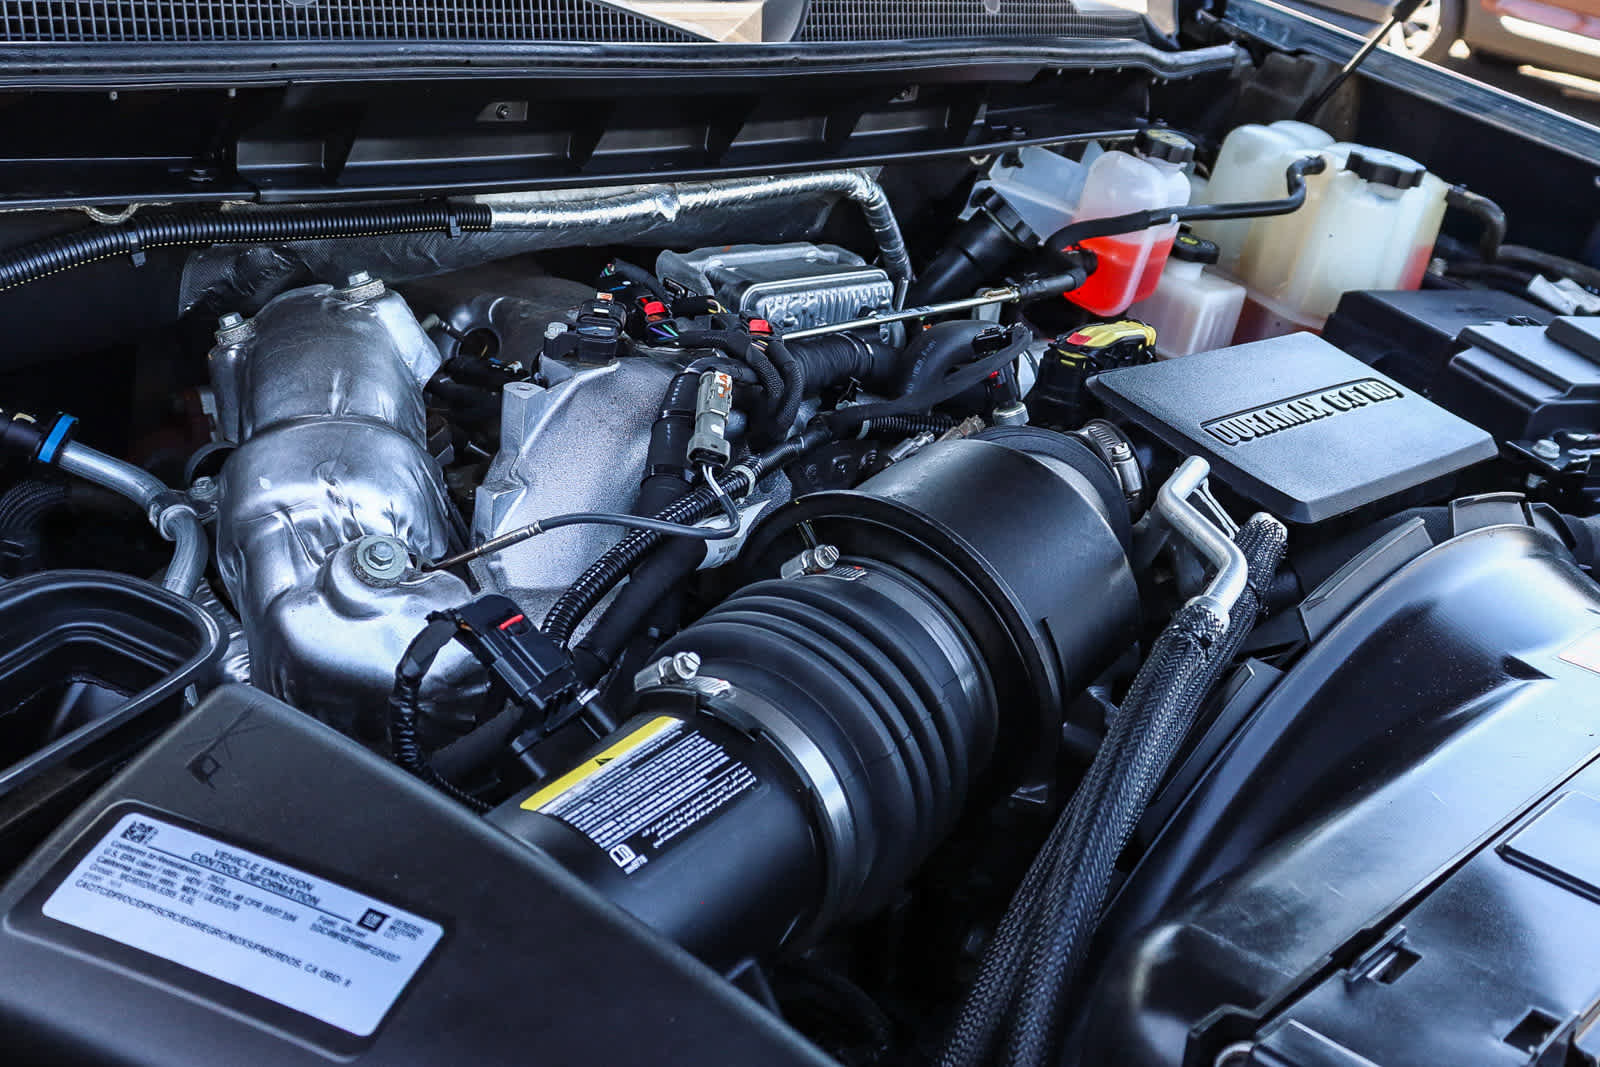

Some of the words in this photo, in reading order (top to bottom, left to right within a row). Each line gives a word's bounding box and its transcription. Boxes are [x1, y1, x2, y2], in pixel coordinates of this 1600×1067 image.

[1203, 397, 1333, 446] DURAMAX
[1355, 381, 1398, 403] HD
[191, 851, 241, 877] CONTROL
[244, 872, 320, 906] INFORMATION
[214, 849, 260, 872] VEHICLE
[261, 866, 315, 891] EMISSION
